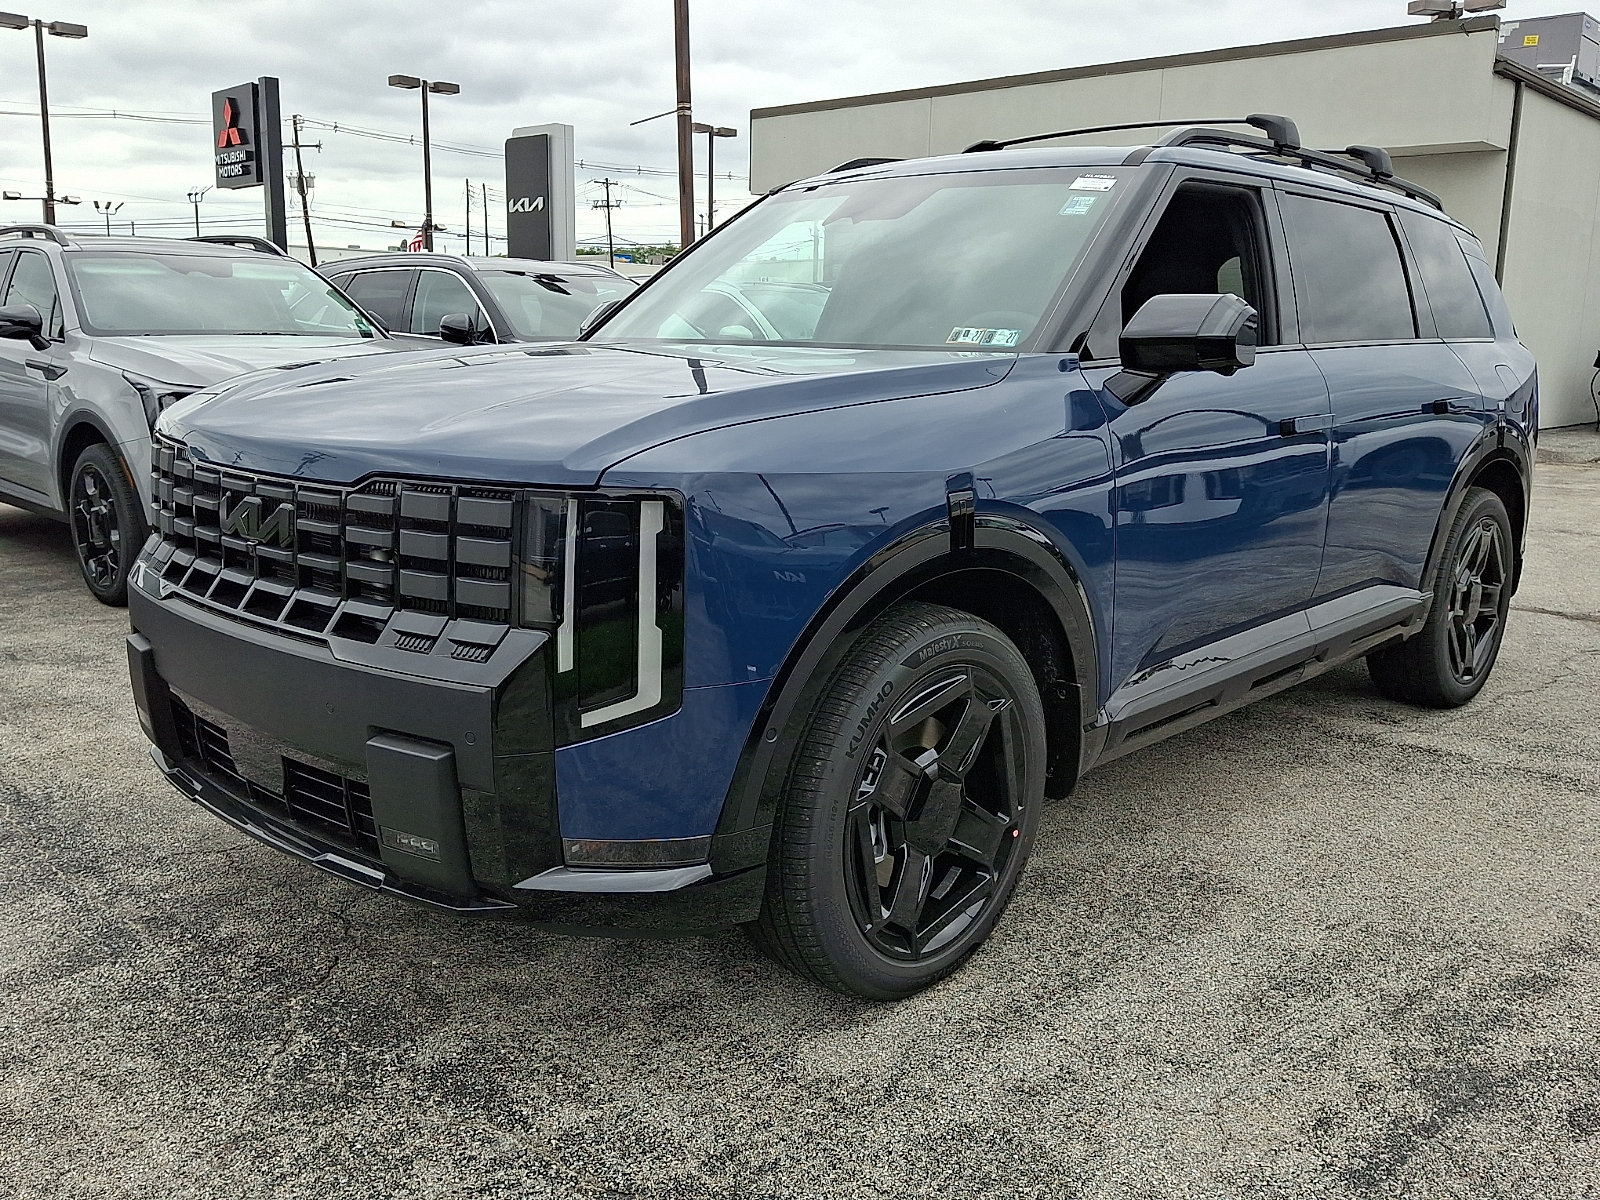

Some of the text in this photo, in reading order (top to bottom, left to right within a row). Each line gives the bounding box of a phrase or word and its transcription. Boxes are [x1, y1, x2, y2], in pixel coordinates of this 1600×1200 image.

[214, 149, 247, 165] MITSUBISHI
[218, 163, 242, 178] MOTORS
[508, 196, 544, 213] KIA
[219, 490, 295, 548] KIA
[845, 680, 895, 759] KUMHO
